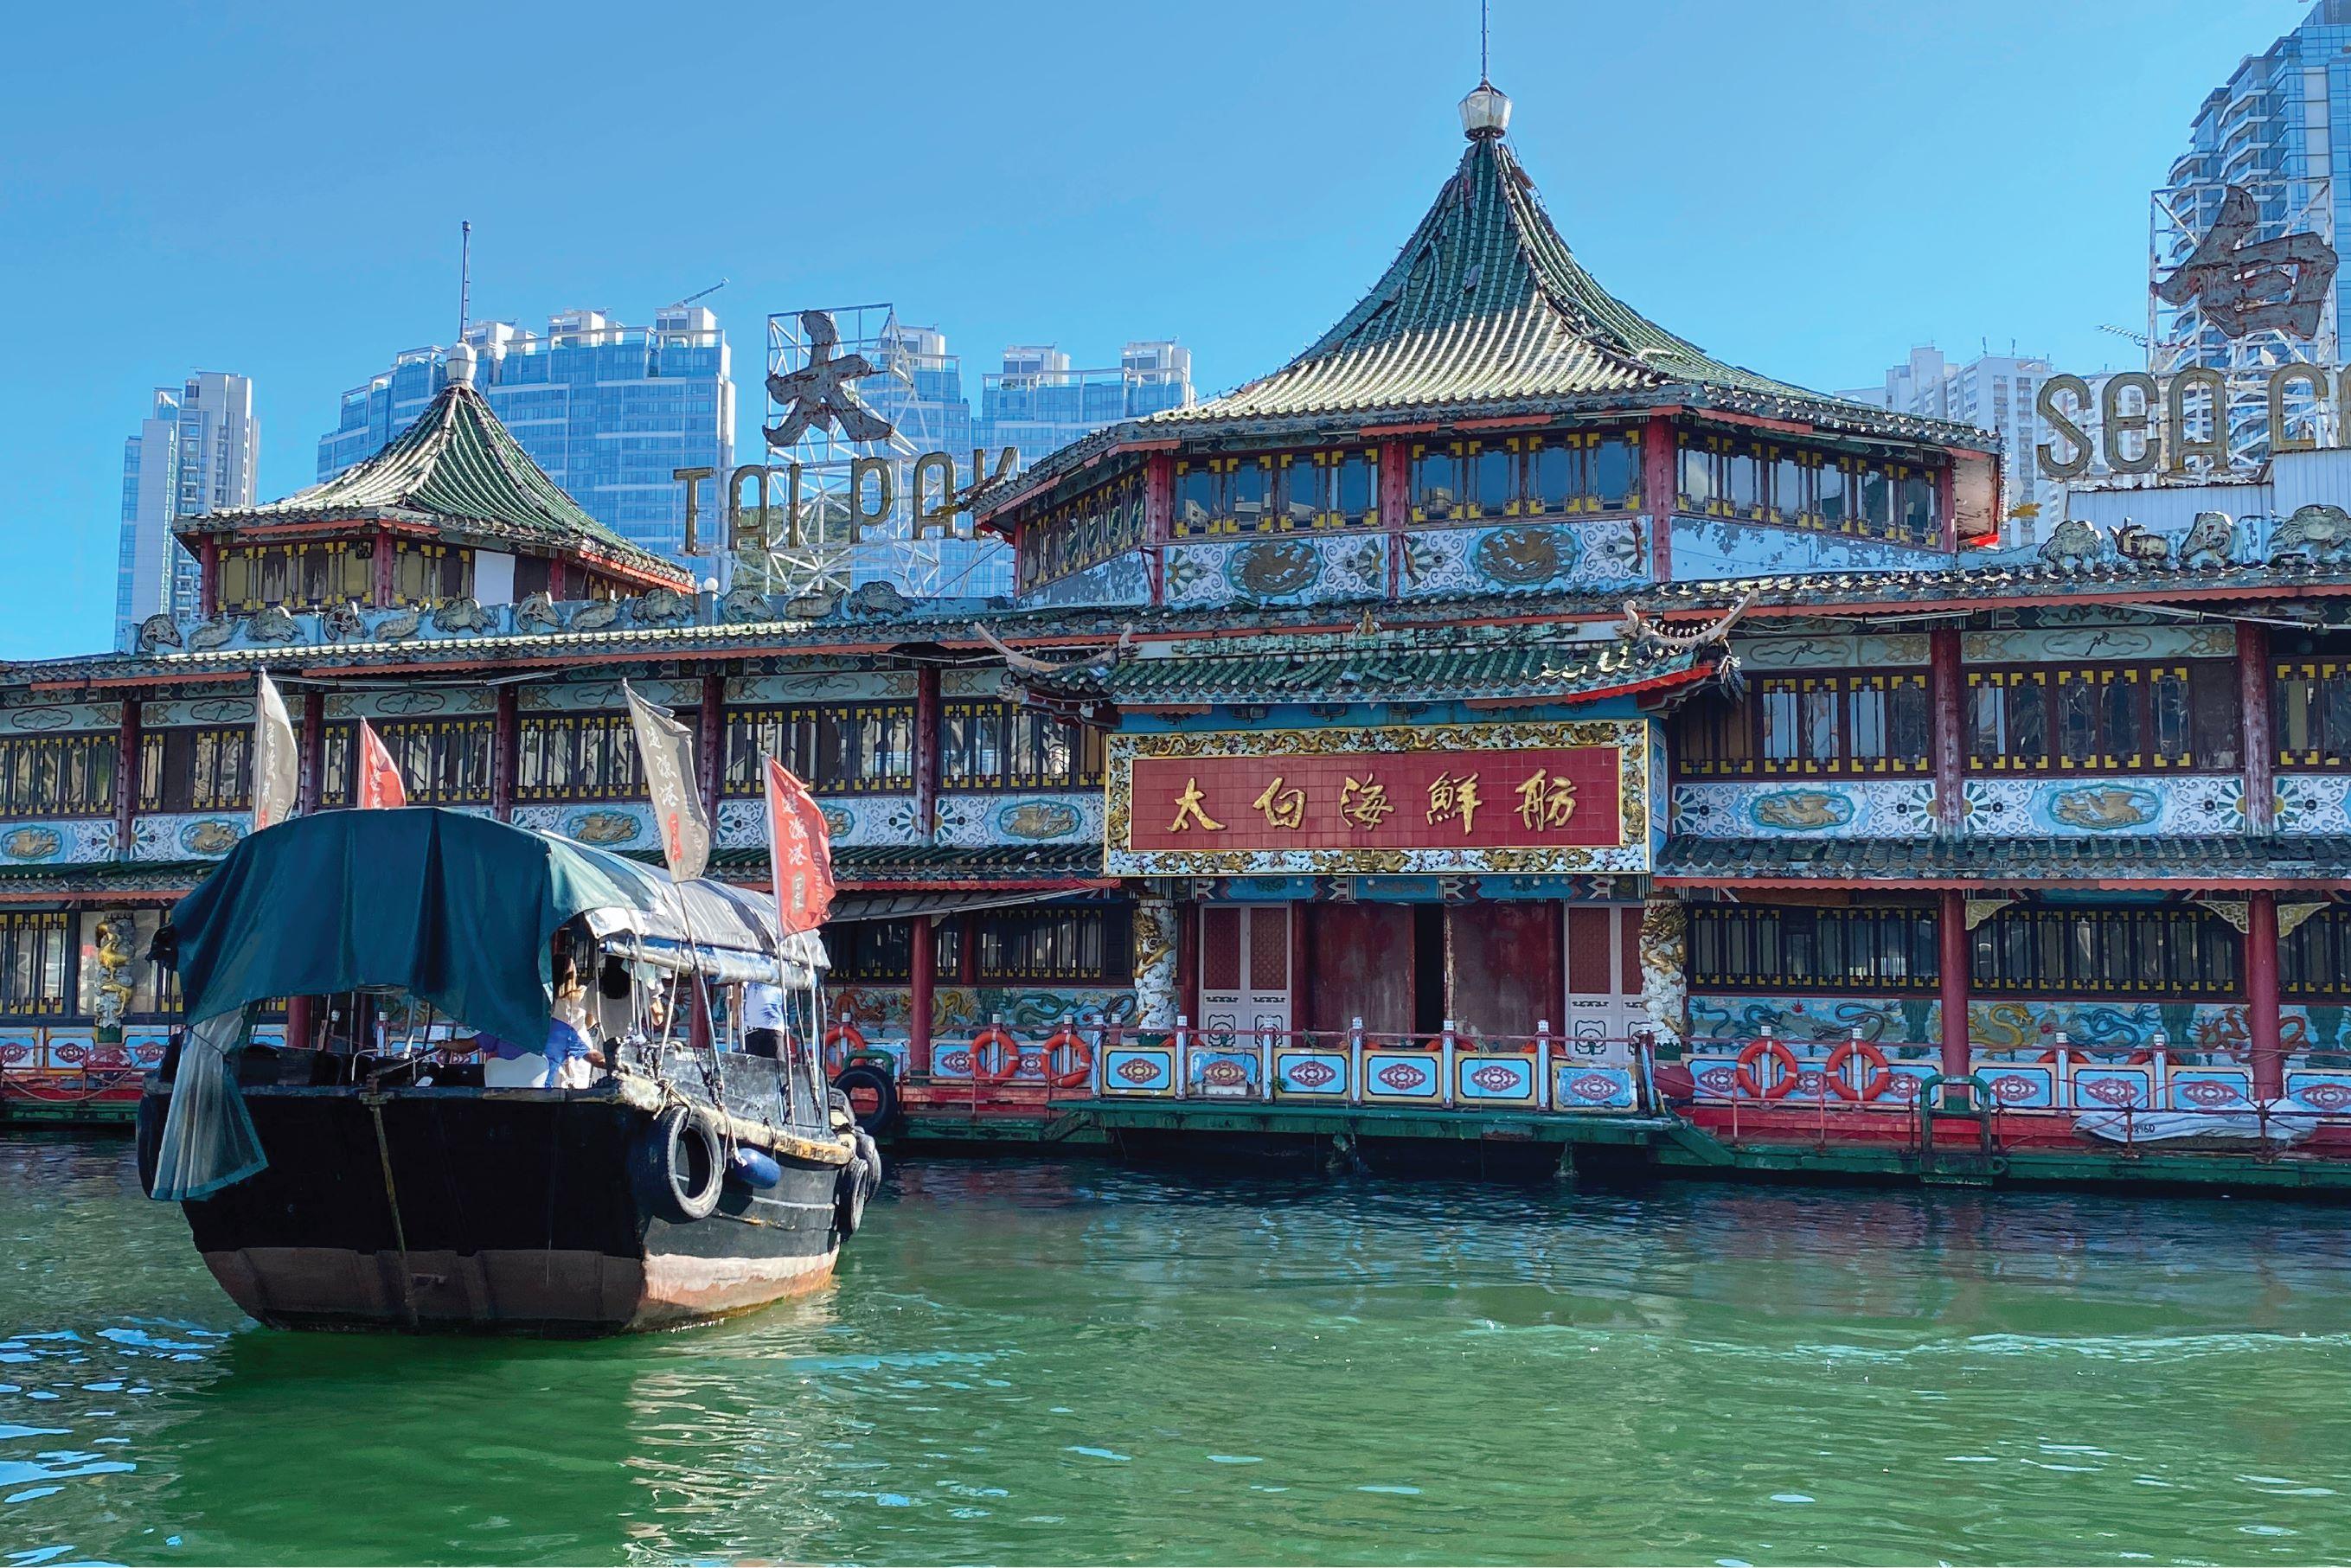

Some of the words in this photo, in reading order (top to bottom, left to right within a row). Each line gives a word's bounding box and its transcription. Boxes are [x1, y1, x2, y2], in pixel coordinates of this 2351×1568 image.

[761, 310, 894, 447] 太
[672, 463, 803, 555] TAI
[1165, 767, 1578, 835] 太白海鮮舫
